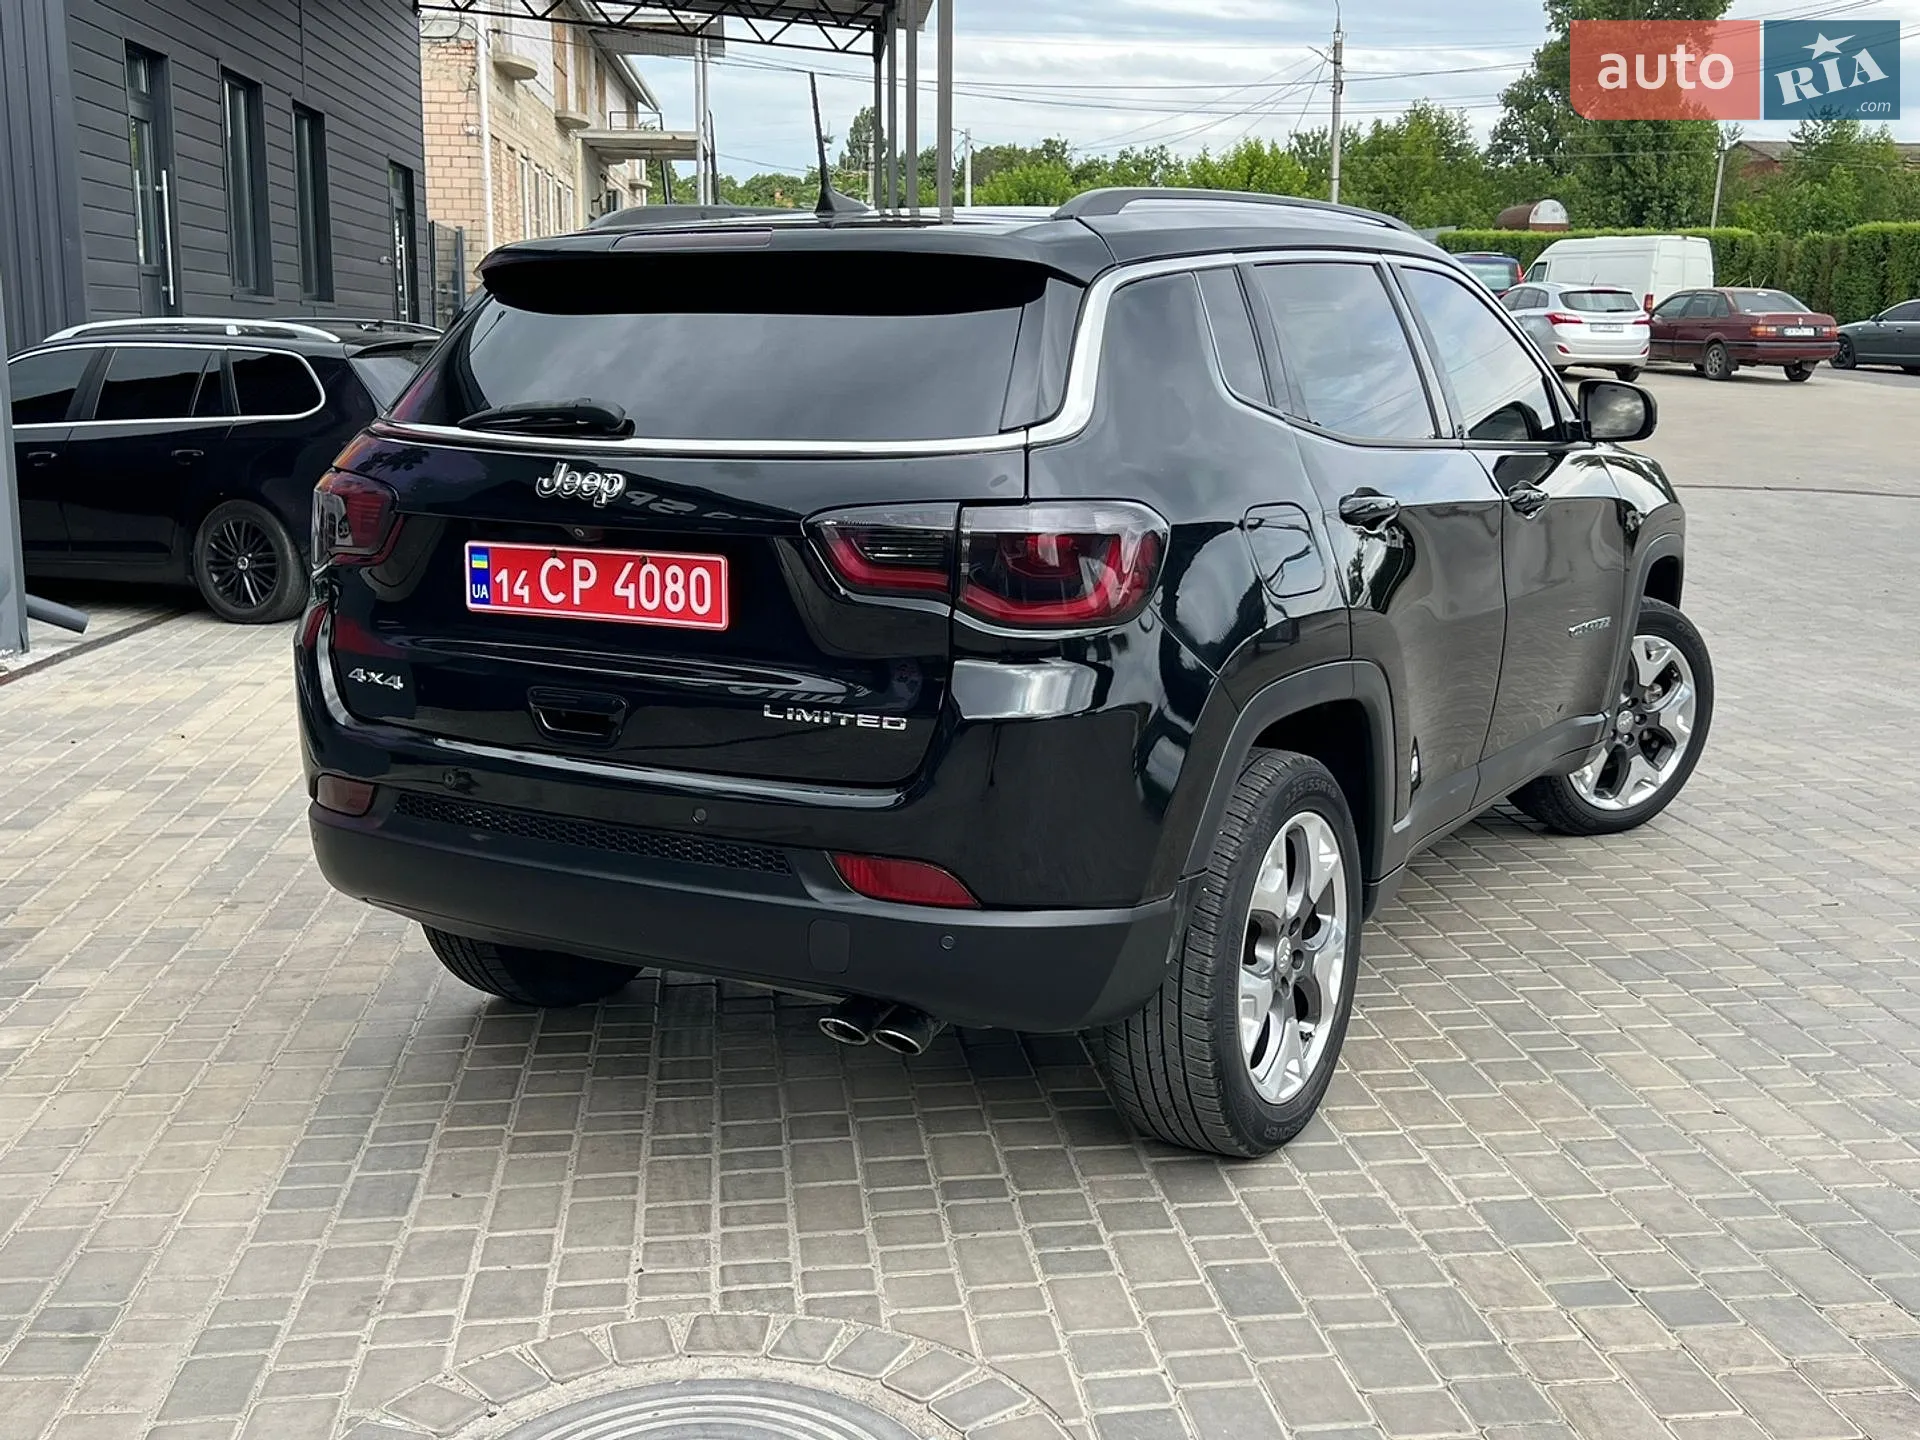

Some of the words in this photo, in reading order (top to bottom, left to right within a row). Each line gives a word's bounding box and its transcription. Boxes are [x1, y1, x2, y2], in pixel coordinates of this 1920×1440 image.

[535, 460, 626, 508] Jeep
[472, 583, 489, 599] UA
[494, 568, 530, 604] 14
[540, 556, 598, 606] CP
[613, 561, 712, 616] 4080
[763, 703, 907, 731] LIMITED
